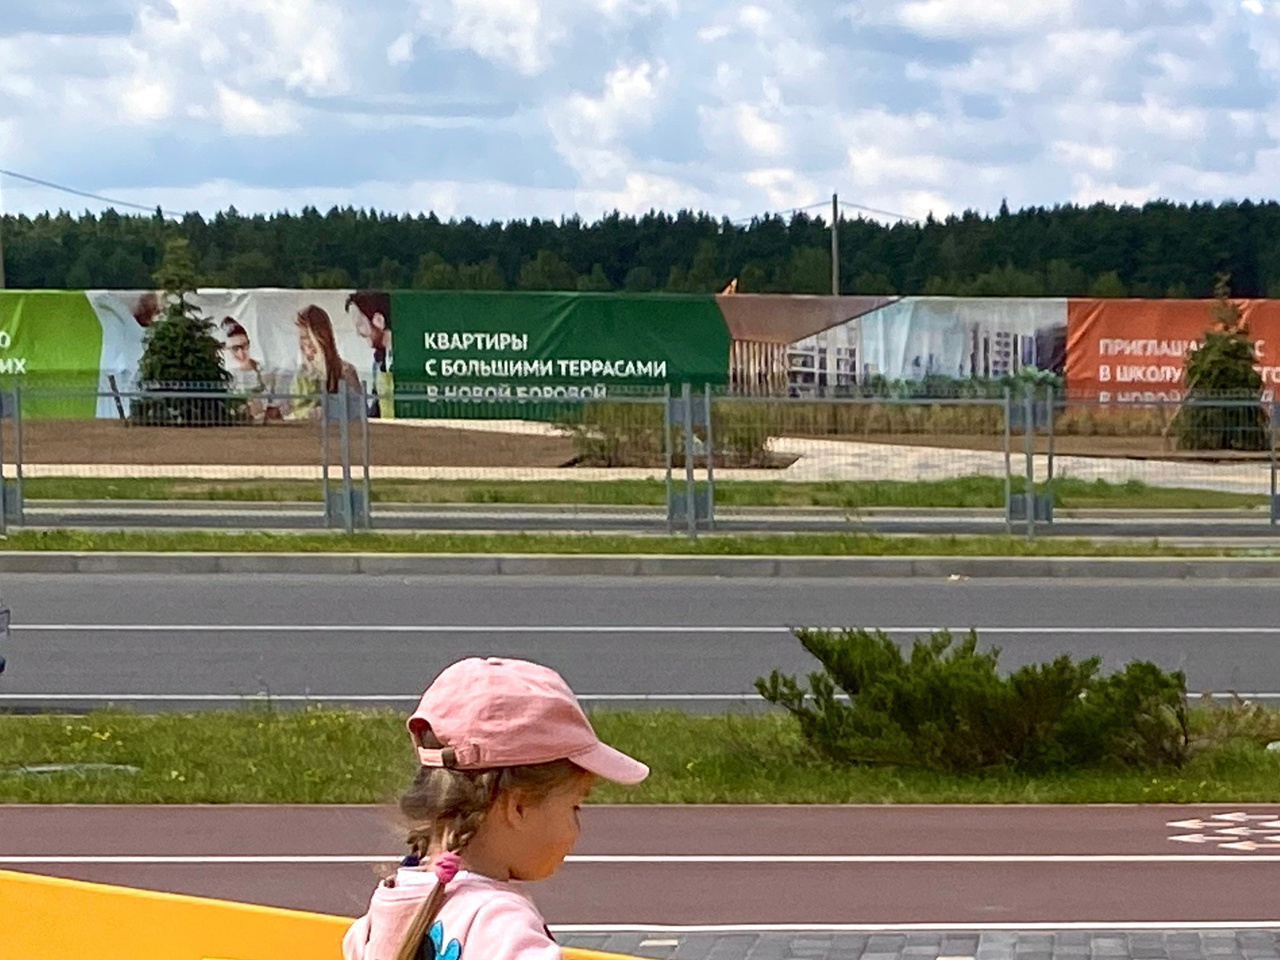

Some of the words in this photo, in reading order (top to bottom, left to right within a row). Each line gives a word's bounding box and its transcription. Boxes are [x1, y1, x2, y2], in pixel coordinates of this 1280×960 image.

[424, 333, 528, 350] КВАРТИРЫ
[1100, 338, 1206, 356] ПРИГЛАША
[425, 360, 437, 376] С
[442, 359, 552, 377] БОЛЬШИМИ
[557, 360, 667, 378] ТЕРРАСАМИ
[1099, 365, 1111, 382] В
[1116, 365, 1182, 384] ШКОЛУ
[444, 382, 511, 402] НОВОЙ
[516, 383, 607, 403] БОРОВОЙ
